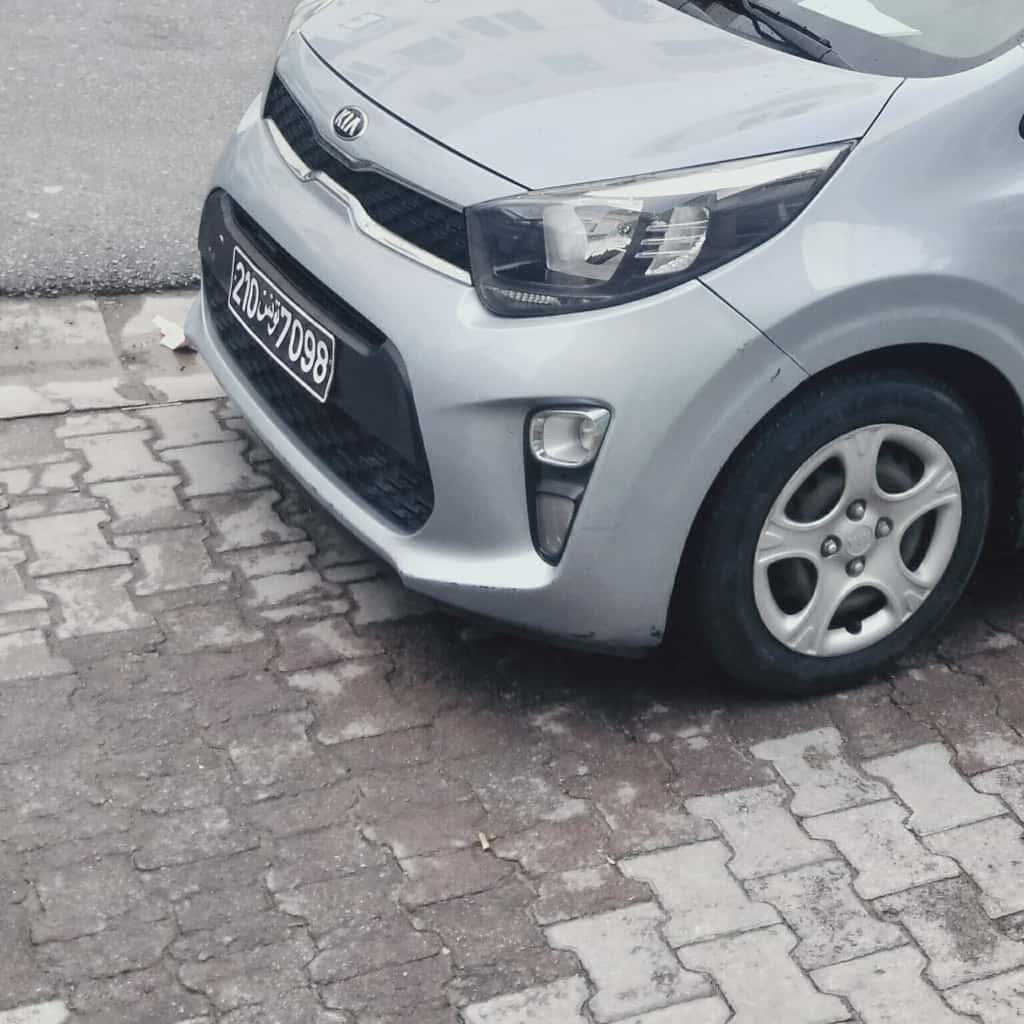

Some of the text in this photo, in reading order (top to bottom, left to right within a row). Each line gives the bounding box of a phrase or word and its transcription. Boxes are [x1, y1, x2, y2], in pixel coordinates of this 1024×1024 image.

[232, 261, 329, 384] 210 تونس 7098
